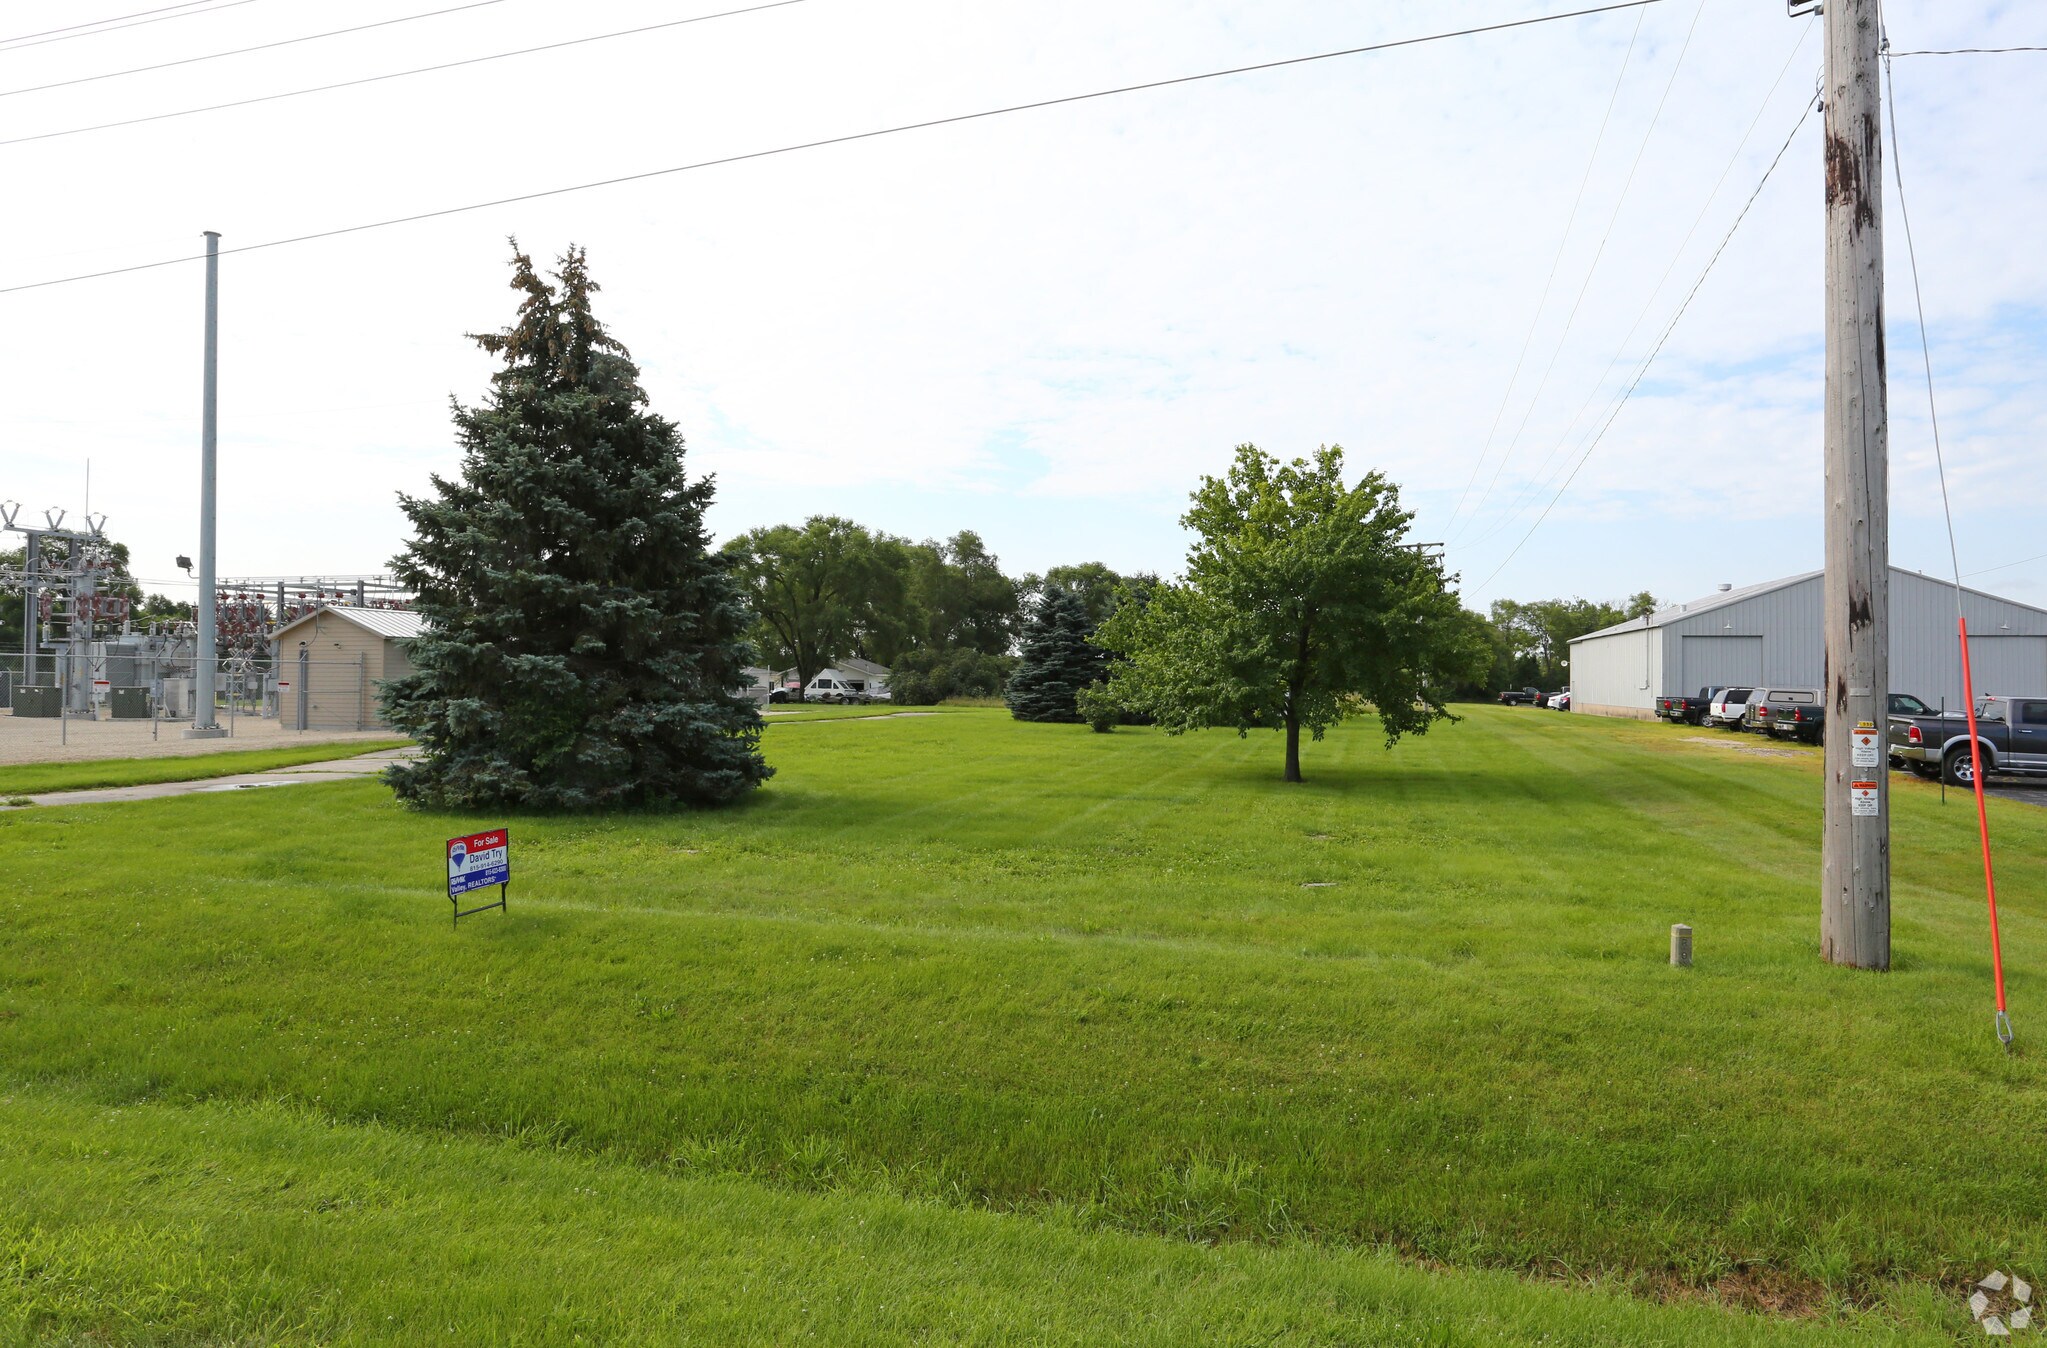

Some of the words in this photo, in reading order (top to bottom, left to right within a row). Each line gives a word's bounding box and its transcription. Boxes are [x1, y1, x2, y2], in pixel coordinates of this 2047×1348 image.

[474, 839, 484, 848] For
[486, 836, 498, 845] Sale
[470, 851, 490, 864] David
[491, 849, 502, 859] Try
